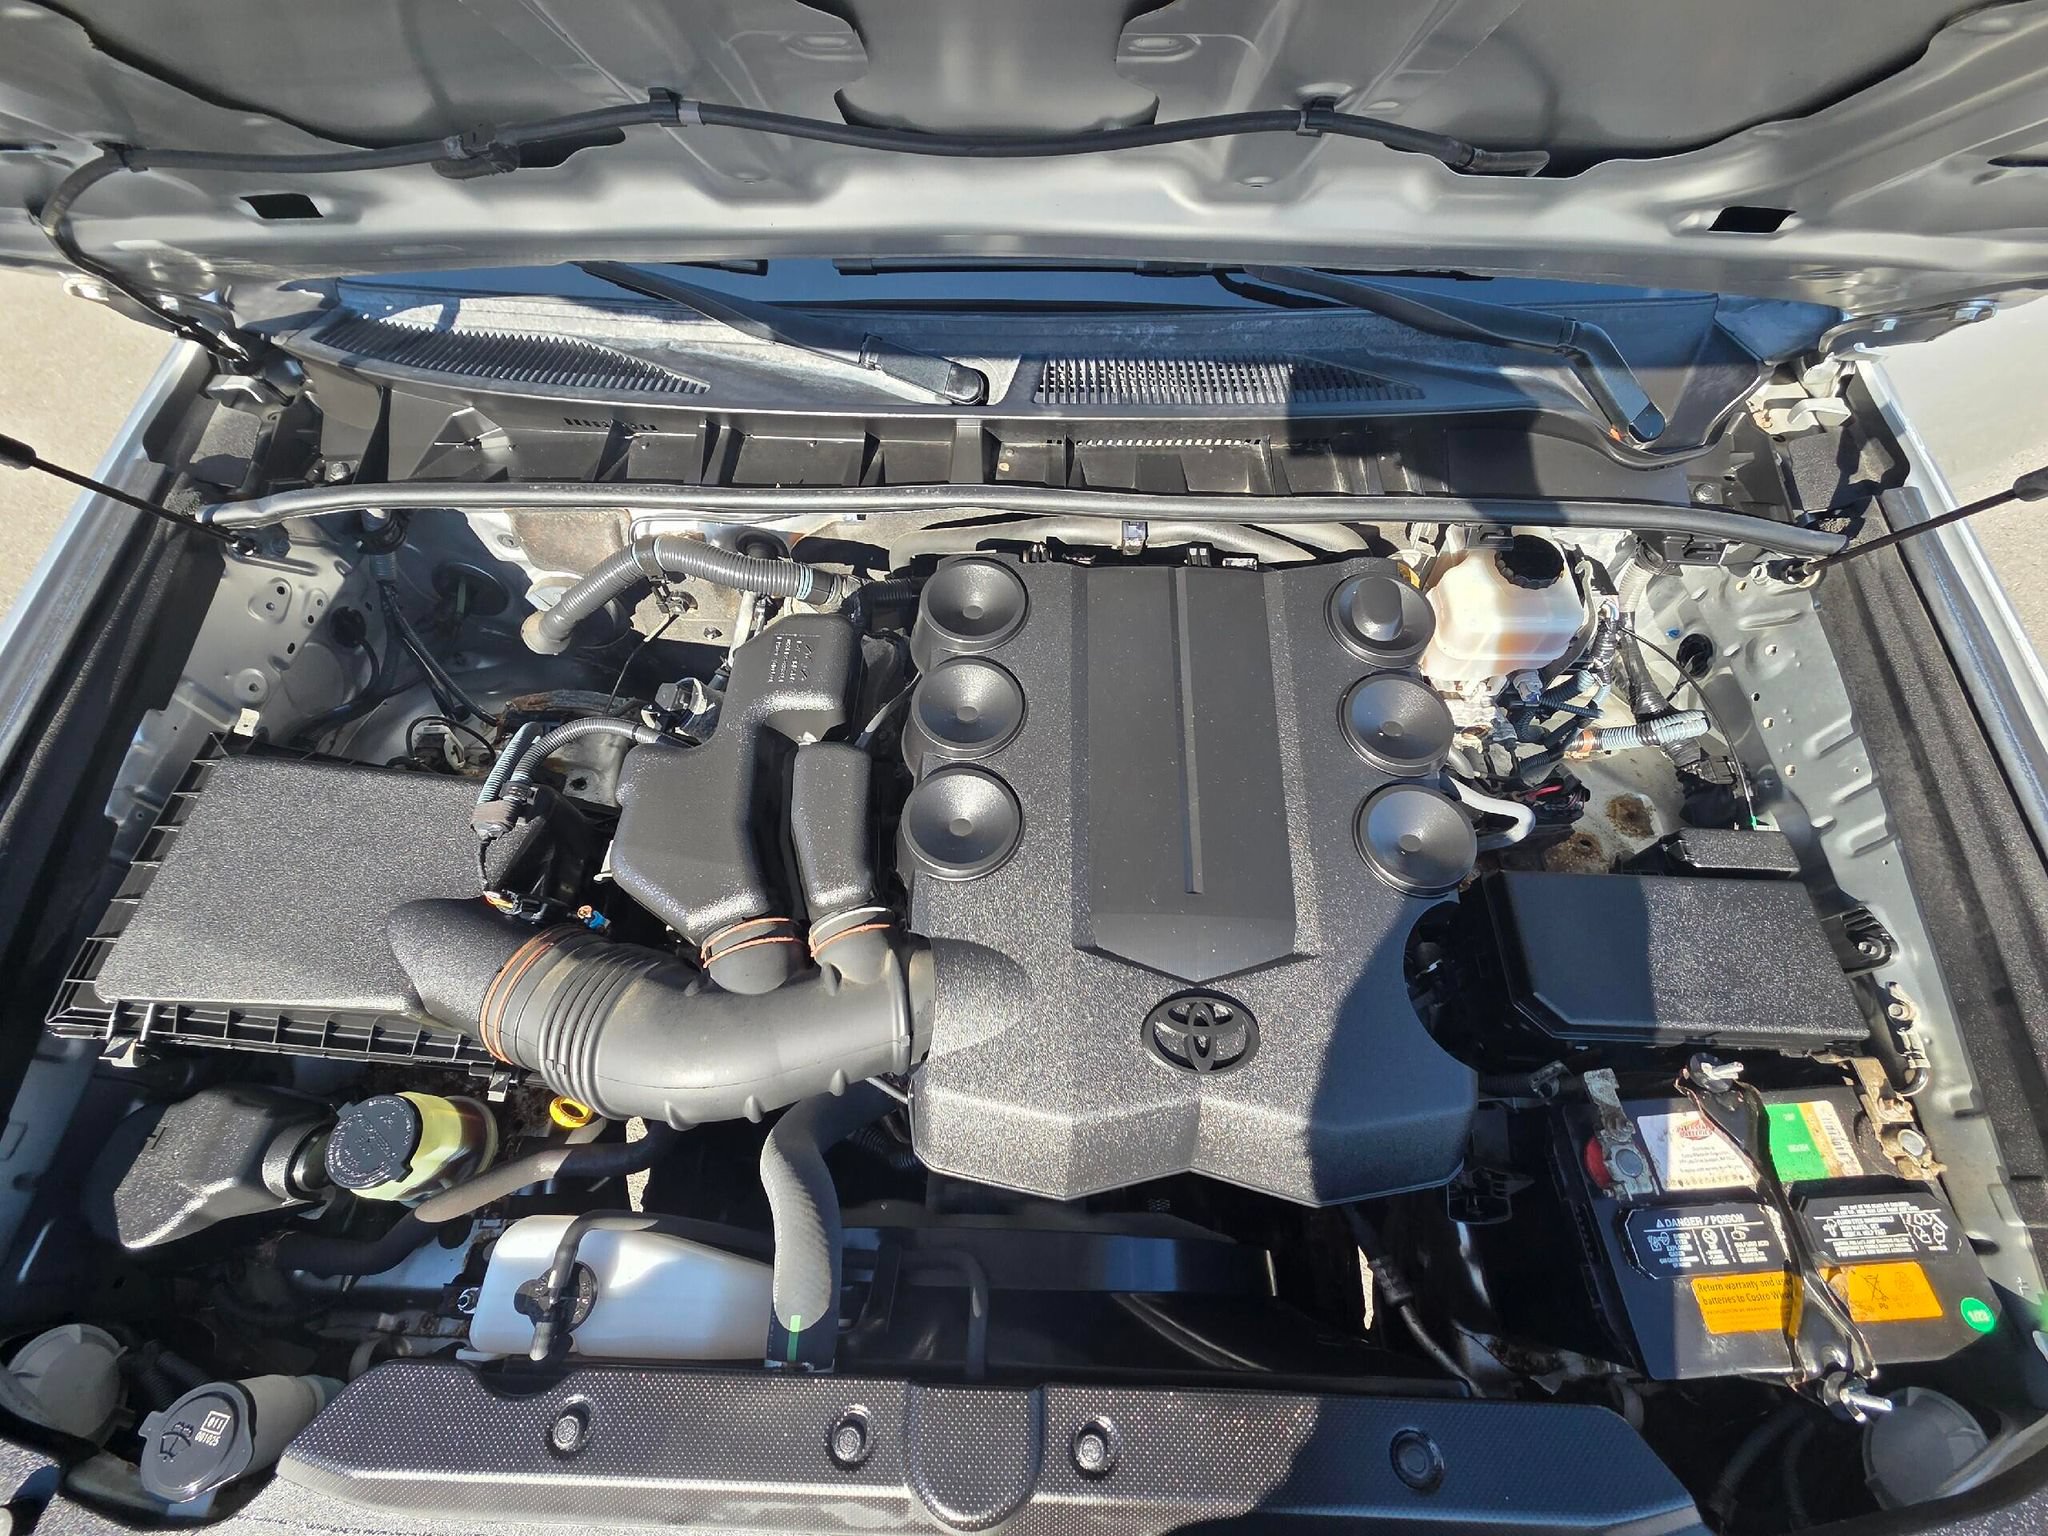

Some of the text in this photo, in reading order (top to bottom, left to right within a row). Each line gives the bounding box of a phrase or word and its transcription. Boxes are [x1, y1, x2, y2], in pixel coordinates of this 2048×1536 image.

[1664, 1216, 1703, 1228] DANGER
[1710, 1213, 1745, 1224] POISON
[1697, 1282, 1725, 1293] Return
[1725, 1280, 1759, 1291] warranty
[1759, 1276, 1775, 1288] and
[1702, 1296, 1737, 1306] batteries
[1737, 1294, 1746, 1303] to
